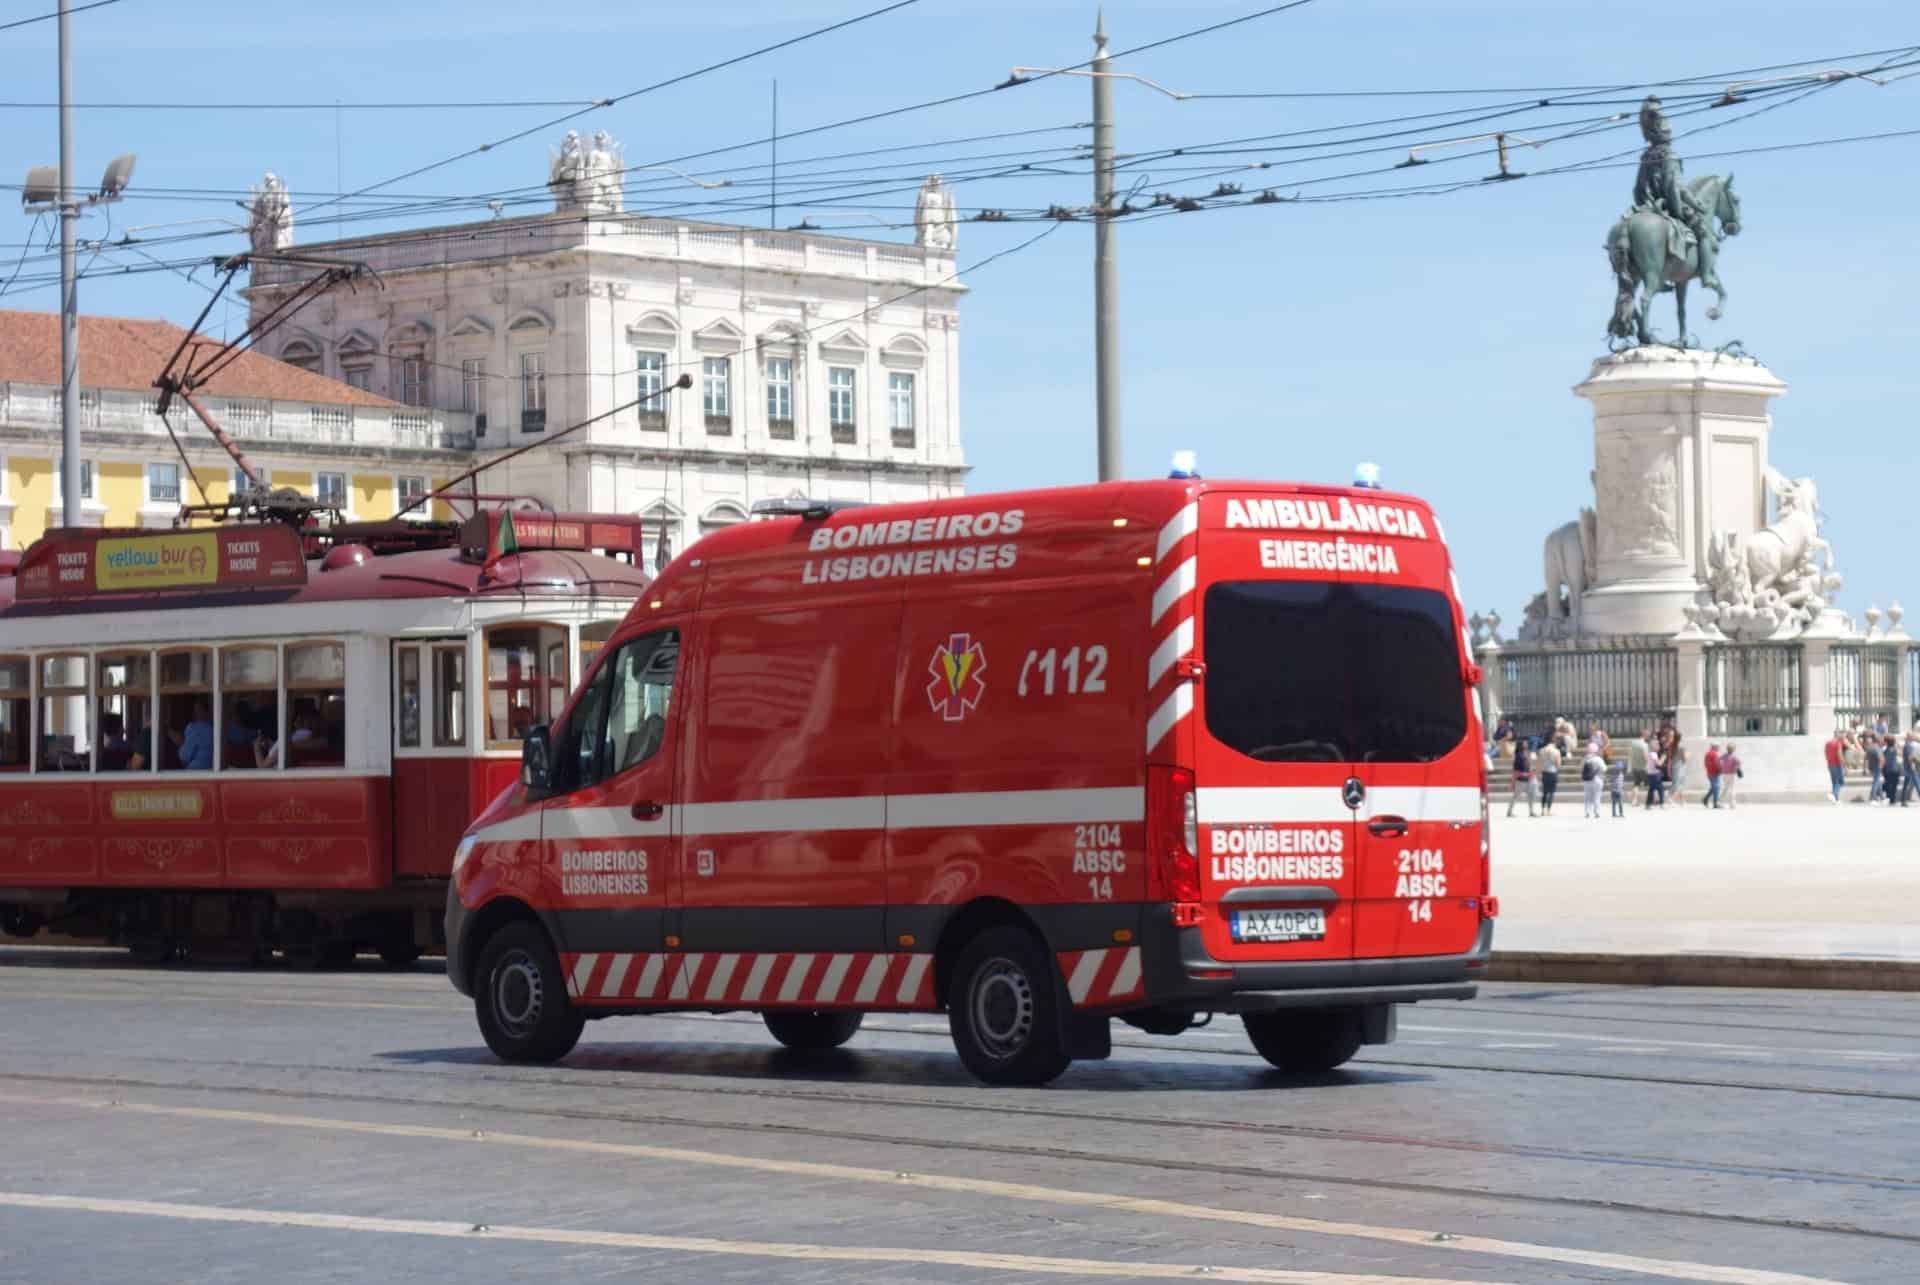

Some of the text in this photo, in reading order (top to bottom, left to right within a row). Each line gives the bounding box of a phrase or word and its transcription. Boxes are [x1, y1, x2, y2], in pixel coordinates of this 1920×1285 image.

[1226, 497, 1428, 539] AMBULÂNCIA
[808, 509, 1025, 552] BOMBEIROS
[57, 552, 88, 565] TICKETS
[226, 541, 260, 554] TICKETS
[1259, 536, 1399, 574] EMERGÊNCIA
[229, 557, 257, 571] INSIDE
[802, 543, 1018, 585] LISBONENSES
[1038, 644, 1109, 696] 112
[1074, 824, 1121, 849] 2104
[1211, 828, 1344, 854] BOMBEIROS
[561, 850, 648, 872] BOMBEIROS
[1072, 850, 1126, 873] ABSC
[1211, 855, 1344, 881] LISBONENSES
[1398, 849, 1444, 873] 2104
[561, 873, 649, 895] LISBONENSES
[1088, 876, 1113, 899] 14
[1395, 874, 1448, 897] ABSC
[1408, 900, 1432, 923] 14
